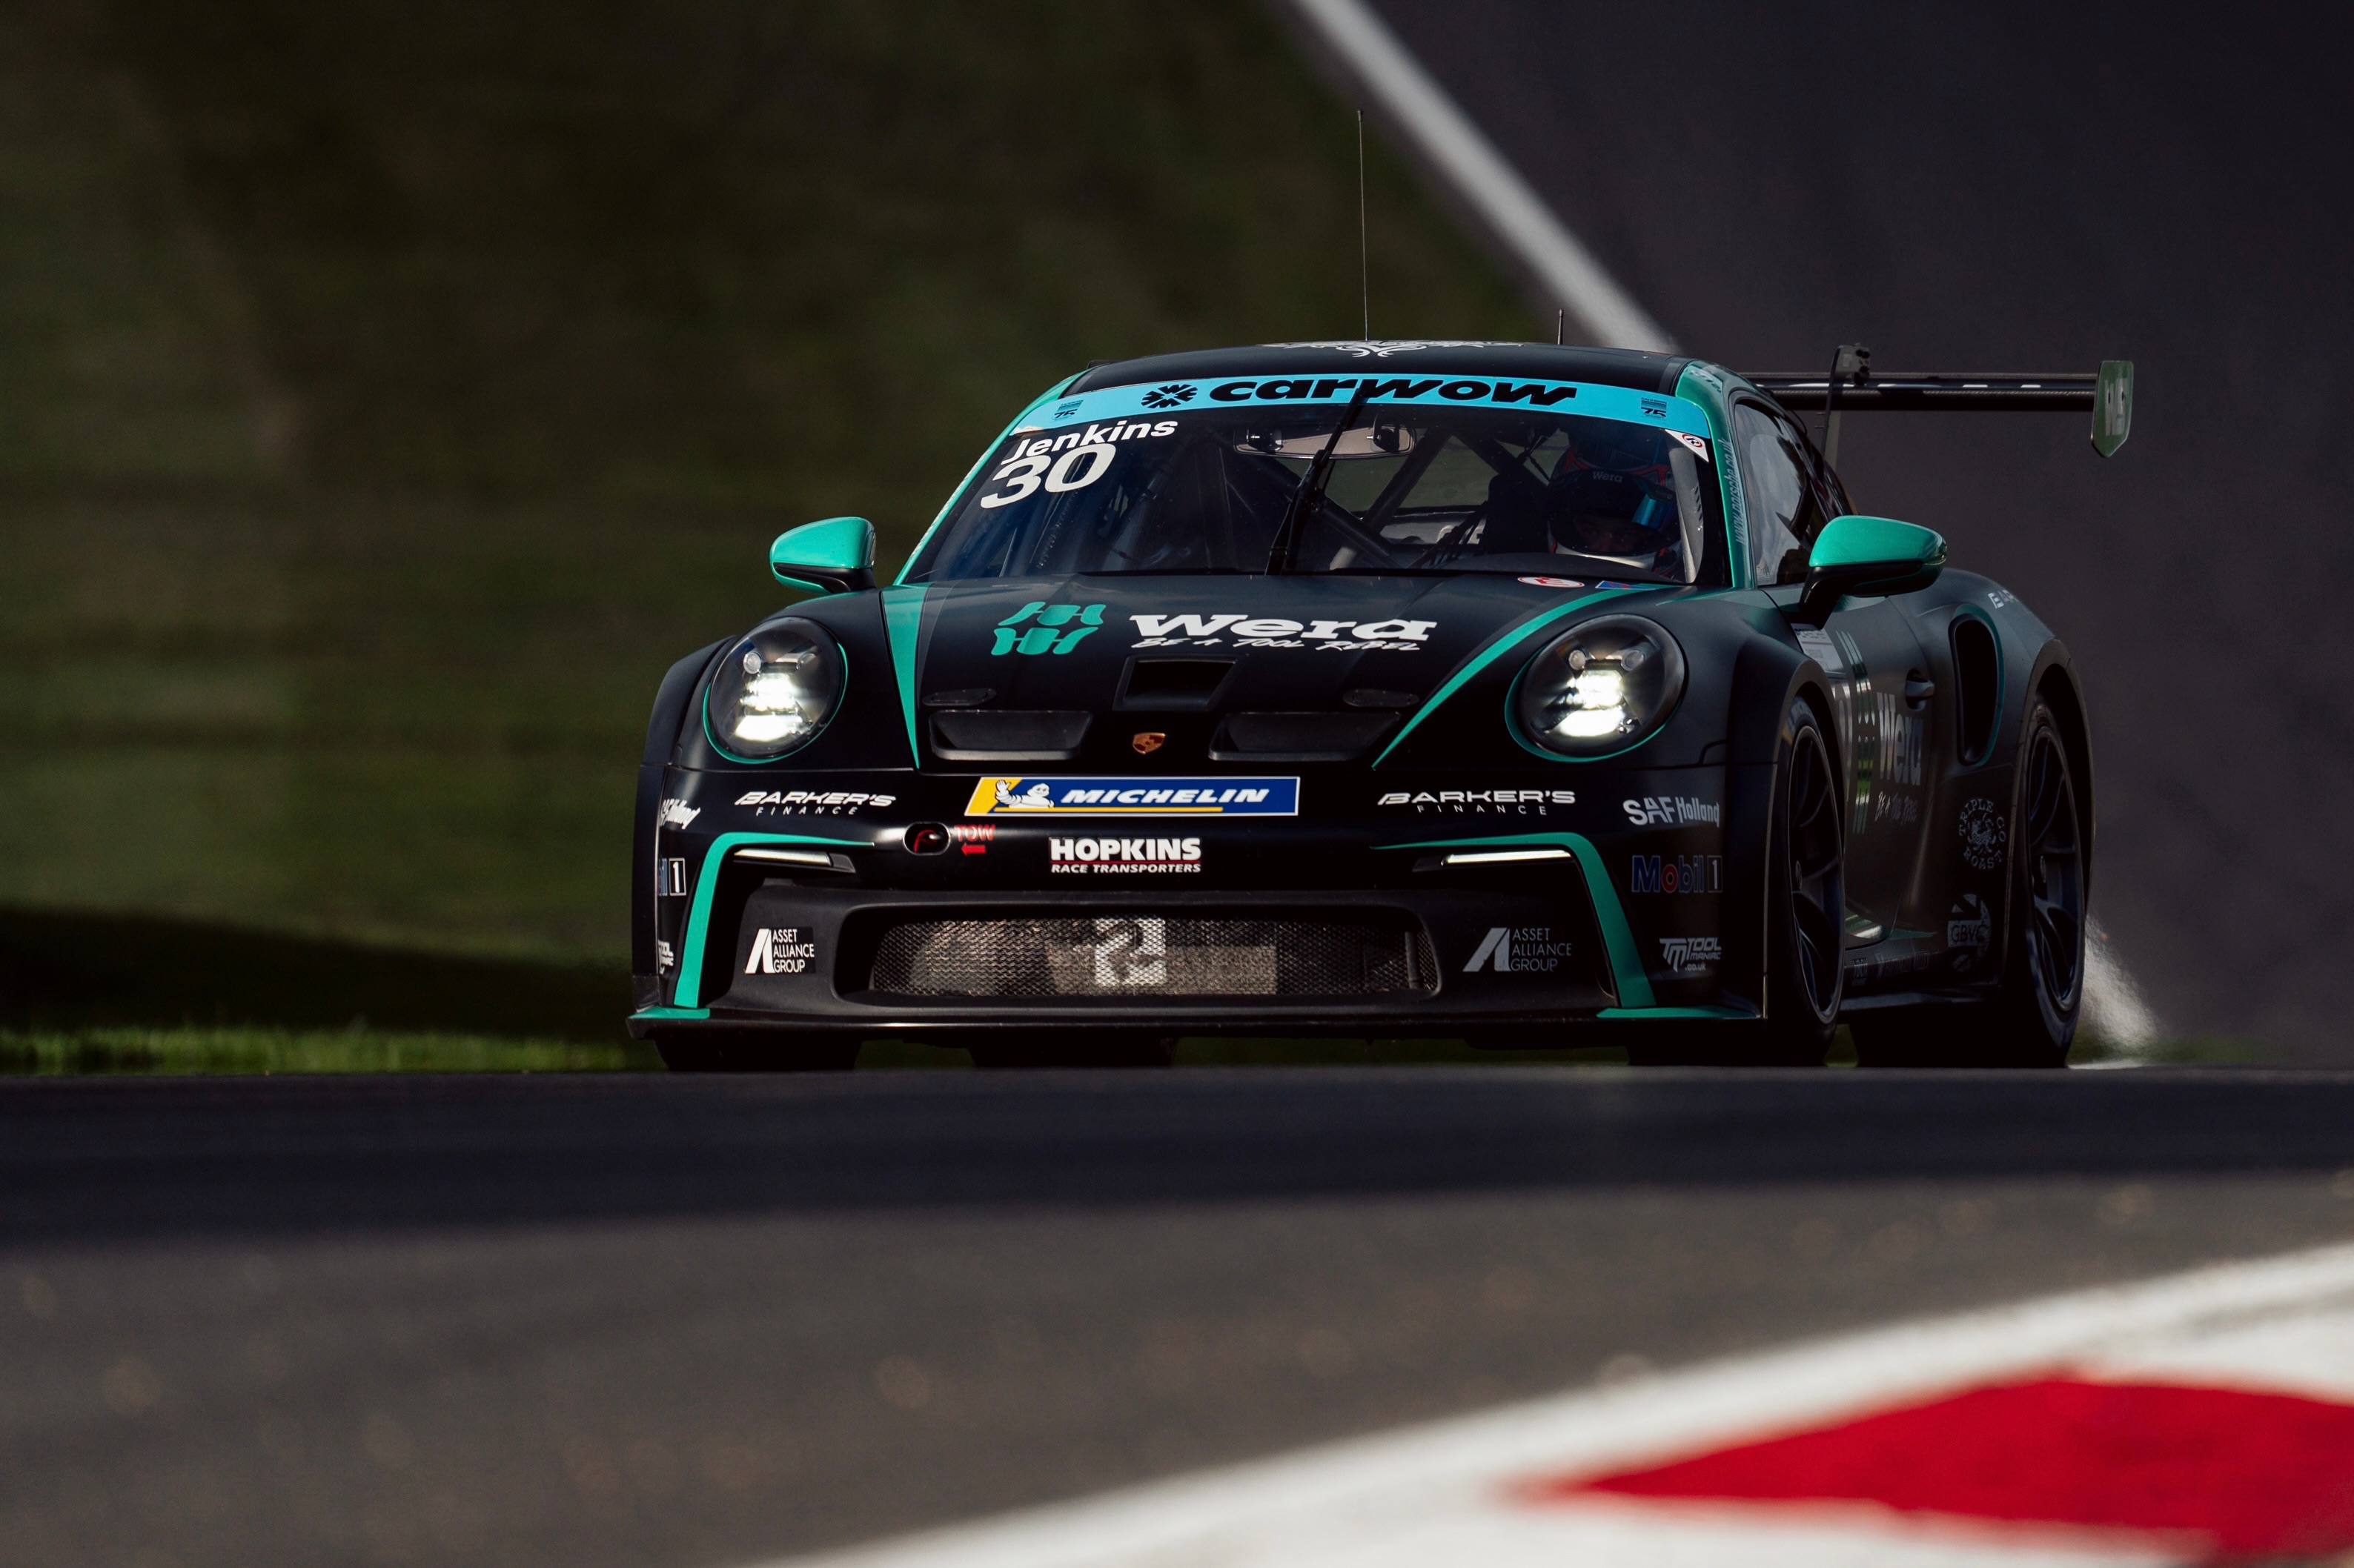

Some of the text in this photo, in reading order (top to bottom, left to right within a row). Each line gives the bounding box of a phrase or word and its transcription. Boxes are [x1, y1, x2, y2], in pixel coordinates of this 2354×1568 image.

[1210, 379, 1578, 405] carwow
[1641, 407, 1667, 417] 75
[1001, 420, 1178, 465] Jenkins
[981, 443, 1116, 508] 30
[1592, 471, 1623, 482] Wera
[1129, 614, 1437, 642] Wera
[1131, 637, 1420, 651] BE A TOOL REBEL
[1877, 691, 1923, 785] Wera
[735, 791, 897, 807] BARKER'S
[1061, 788, 1270, 804] MICHELIN
[1377, 790, 1576, 805] BARKER'S
[756, 806, 858, 817] FINANCE
[1417, 805, 1548, 816] FINANCE
[1623, 797, 1720, 827] SAF Holland
[1958, 799, 1994, 836] TRIPLE
[954, 824, 996, 842] TOW
[1050, 837, 1201, 861] HOPKINS
[1963, 846, 2003, 869] ROAST
[1051, 864, 1201, 874] RACE TRANSPORTERS
[1631, 855, 1704, 894] Mobil
[772, 929, 798, 943] ASSET
[1513, 928, 1551, 941] ASSET
[1952, 924, 1988, 943] GBVC
[773, 944, 815, 957] ALLIANCE
[1512, 943, 1572, 956] ALLIANCE
[1687, 937, 1722, 952] TOOL
[1691, 951, 1721, 960] MANIAC
[773, 959, 806, 973] GROUP
[1511, 958, 1557, 971] GROUP
[1685, 963, 1706, 971] .co.uk
